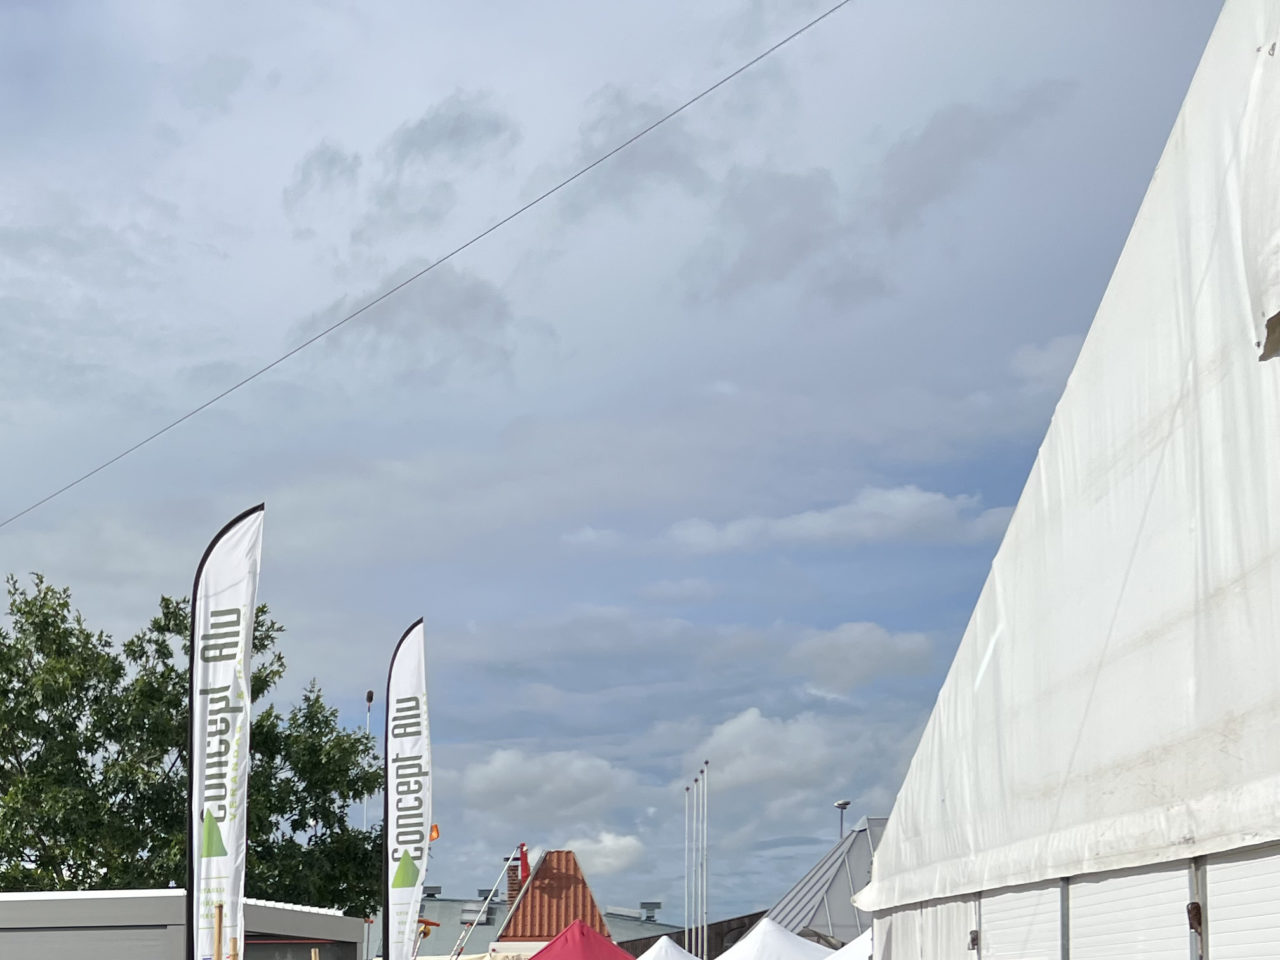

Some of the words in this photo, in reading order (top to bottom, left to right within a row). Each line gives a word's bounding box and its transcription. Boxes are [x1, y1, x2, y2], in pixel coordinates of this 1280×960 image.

[200, 608, 241, 663] Alu
[200, 684, 243, 824] Concept
[392, 695, 422, 739] Alu
[392, 752, 430, 862] Concept
